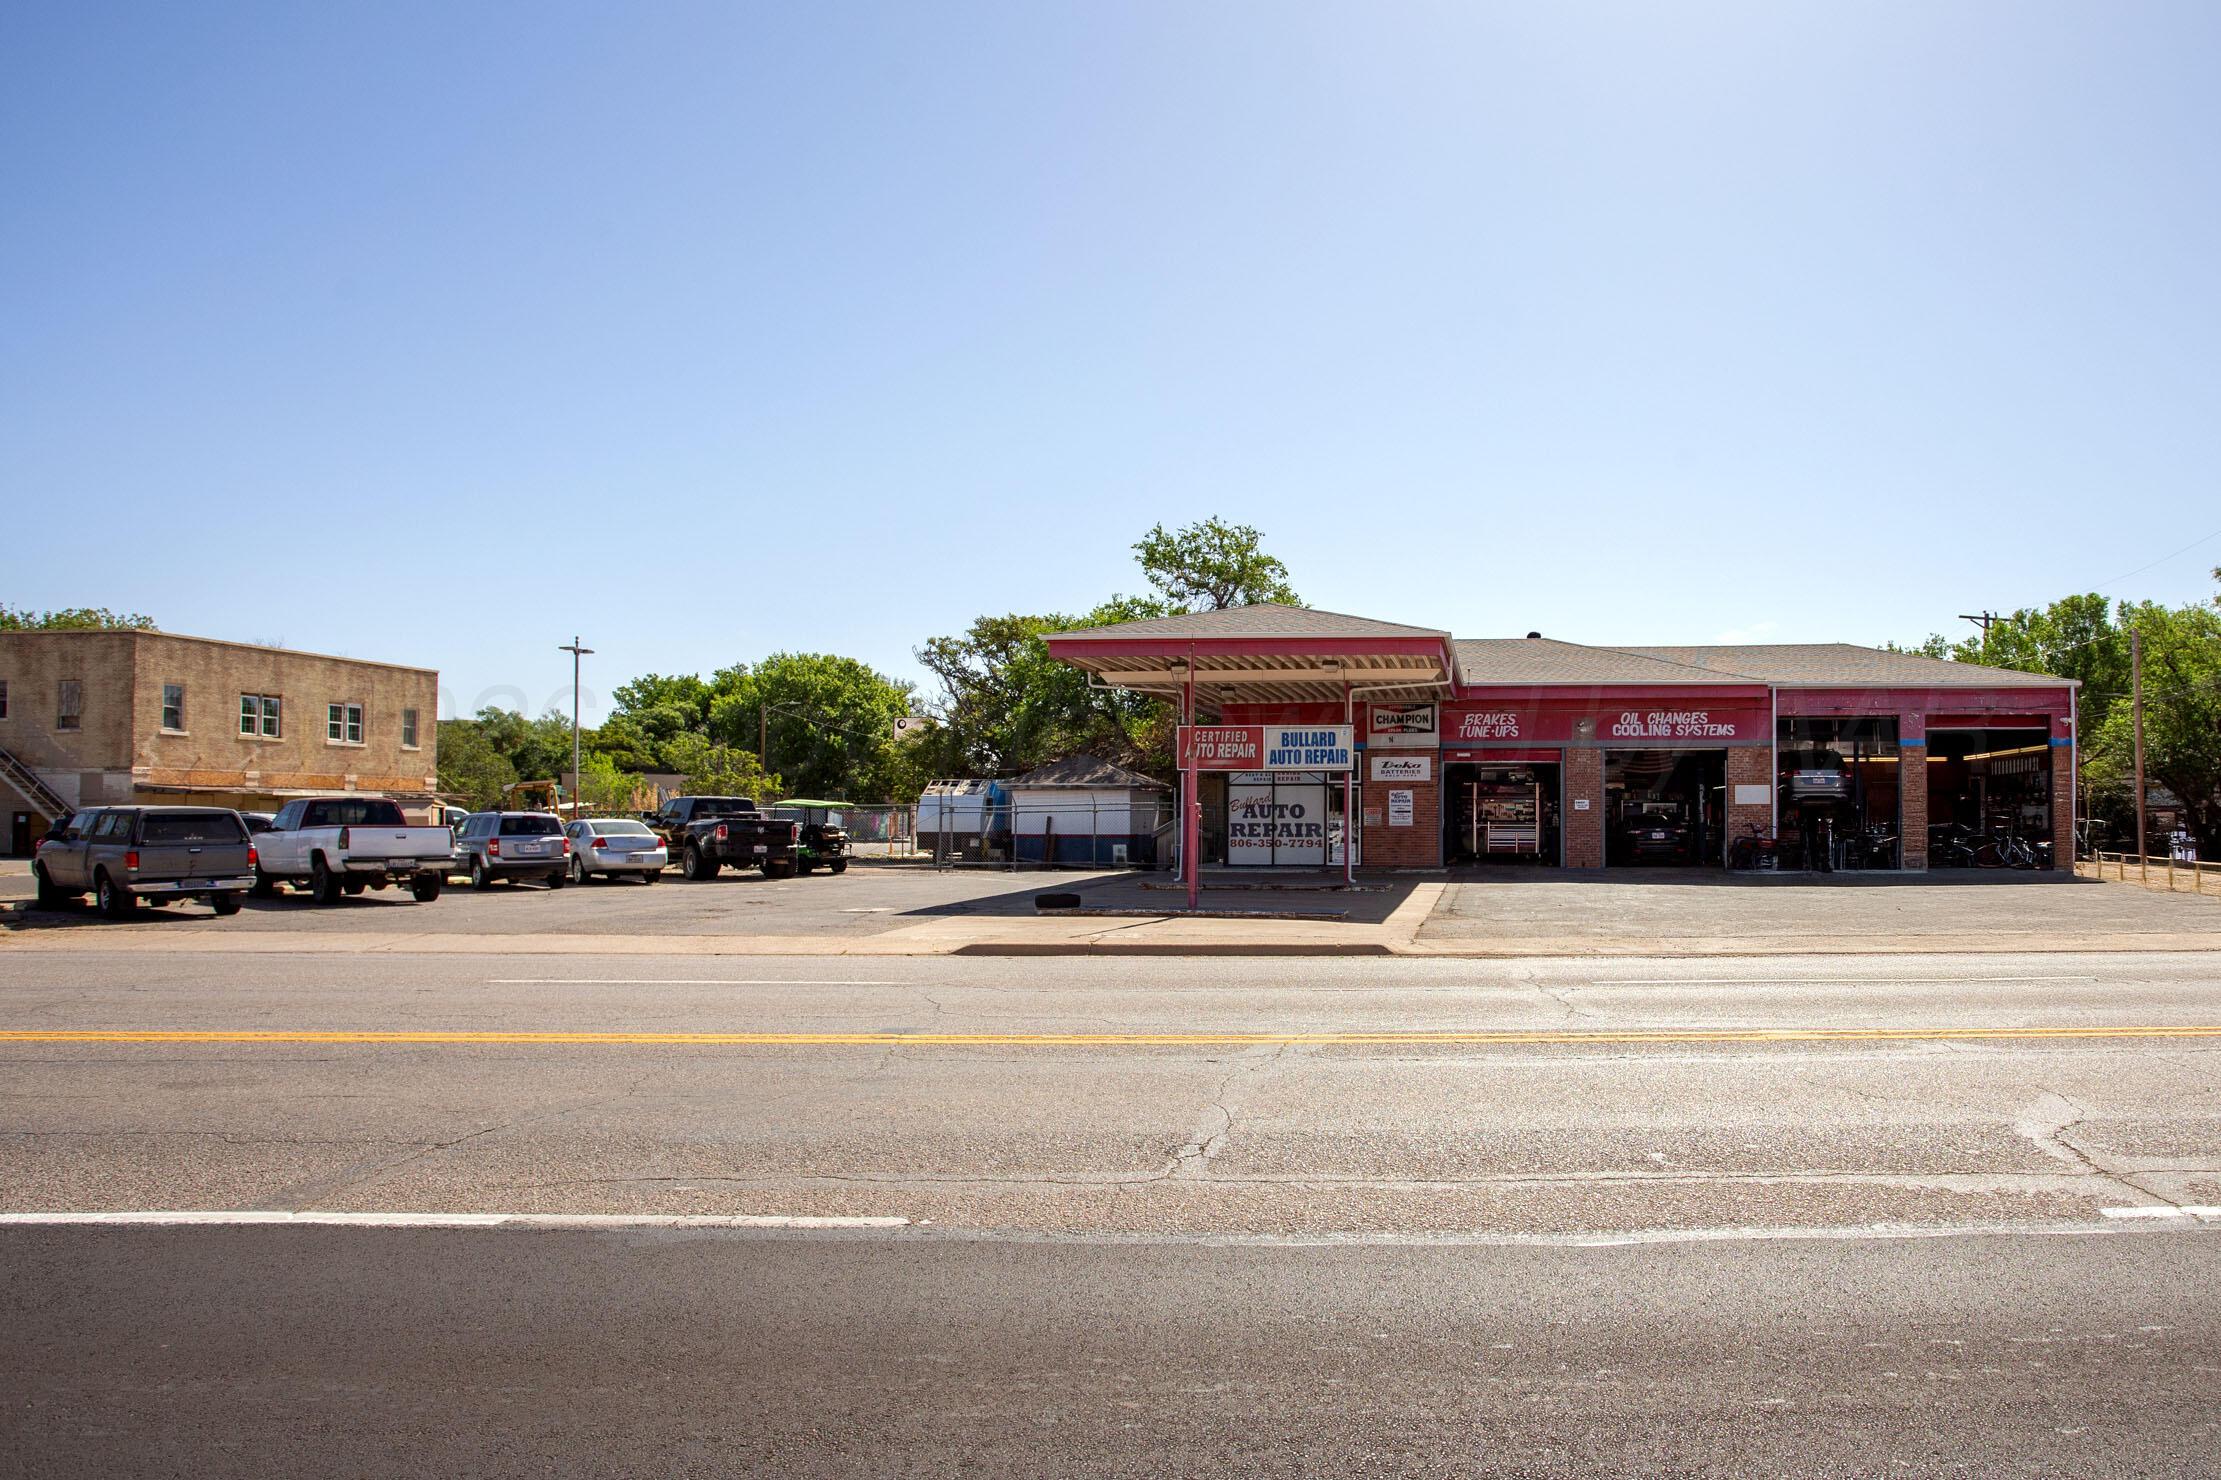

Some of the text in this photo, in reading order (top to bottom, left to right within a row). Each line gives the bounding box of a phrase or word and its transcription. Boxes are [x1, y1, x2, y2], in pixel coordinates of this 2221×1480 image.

[1376, 714, 1429, 724] CHAMPION
[1464, 713, 1517, 725] BRAKES
[1621, 712, 1708, 724] OIL CHANGES
[1612, 724, 1736, 736] COOLING SYSTEMS
[1195, 731, 1248, 742] CERTIFIED
[1281, 732, 1336, 747] BULLARD
[1388, 736, 1394, 744] N
[1217, 743, 1256, 758] REPAIR
[1269, 749, 1349, 764] AUTO REPAIR
[1229, 792, 1272, 812] Bullard
[1242, 804, 1306, 819] AUTO
[1230, 823, 1323, 837] REPAIR
[1230, 839, 1323, 847] 806-350-7794
